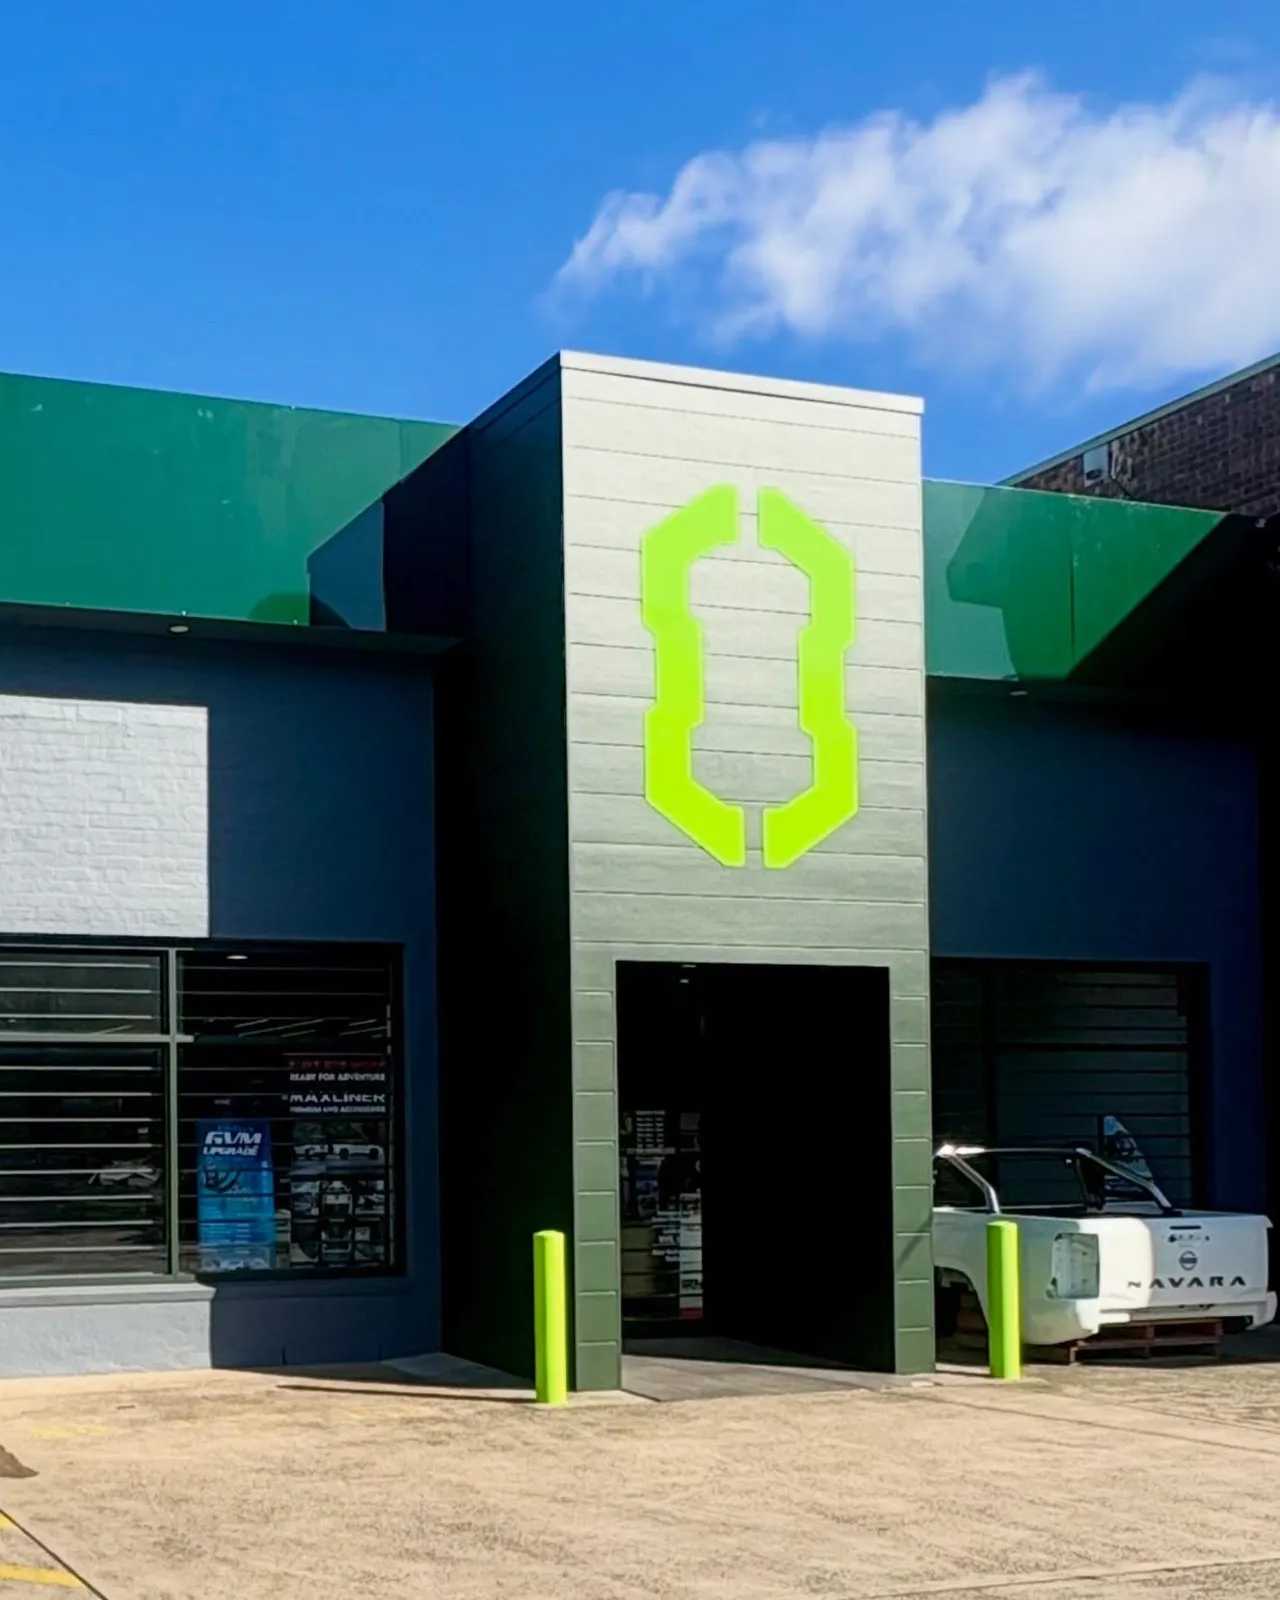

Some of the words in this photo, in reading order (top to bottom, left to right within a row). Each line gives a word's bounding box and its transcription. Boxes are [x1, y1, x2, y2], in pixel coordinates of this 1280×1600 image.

[204, 1131, 262, 1145] GVM
[203, 1146, 260, 1156] UPGRADE
[1126, 1275, 1247, 1289] NAVARA
